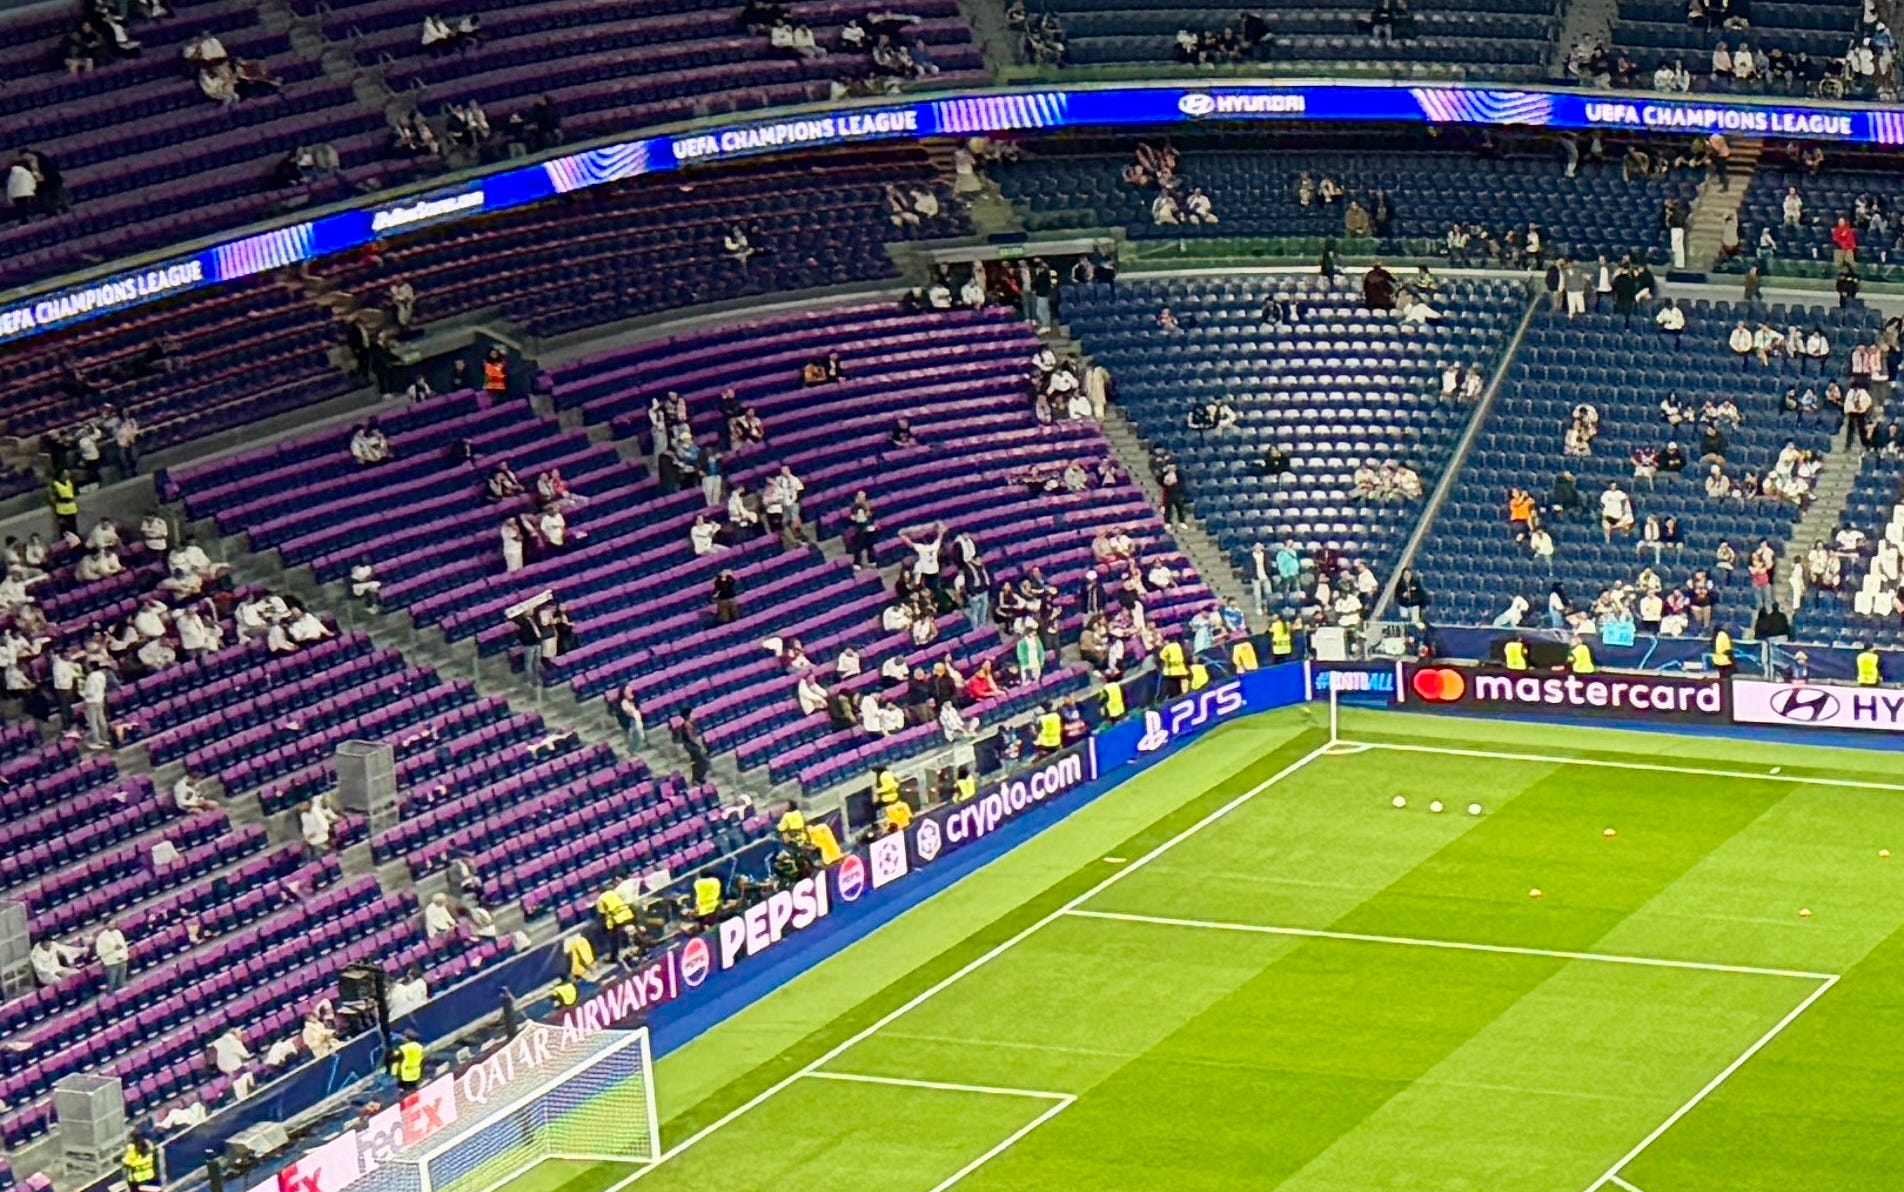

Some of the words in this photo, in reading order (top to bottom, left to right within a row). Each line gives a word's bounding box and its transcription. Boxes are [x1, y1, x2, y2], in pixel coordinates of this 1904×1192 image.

[1217, 95, 1306, 114] HYUNDAI
[1585, 102, 1640, 126] UEFA
[1641, 105, 1768, 133] CHAMPIONS
[1770, 112, 1852, 136] LEAGUE
[674, 137, 720, 160] UEFA
[721, 119, 834, 153] CHAMPIONS
[838, 110, 917, 136] LEAGUE
[0, 308, 36, 337] EFA
[35, 278, 137, 324] CHAMPIONS
[138, 260, 203, 295] LEAGUE
[1170, 682, 1245, 741] PS5
[1473, 673, 1721, 713] mastercard
[946, 752, 1082, 843] crypto.com
[719, 870, 829, 970] PEPSI
[464, 1028, 552, 1105] QATAR
[560, 963, 665, 1051] AIRWAYS
